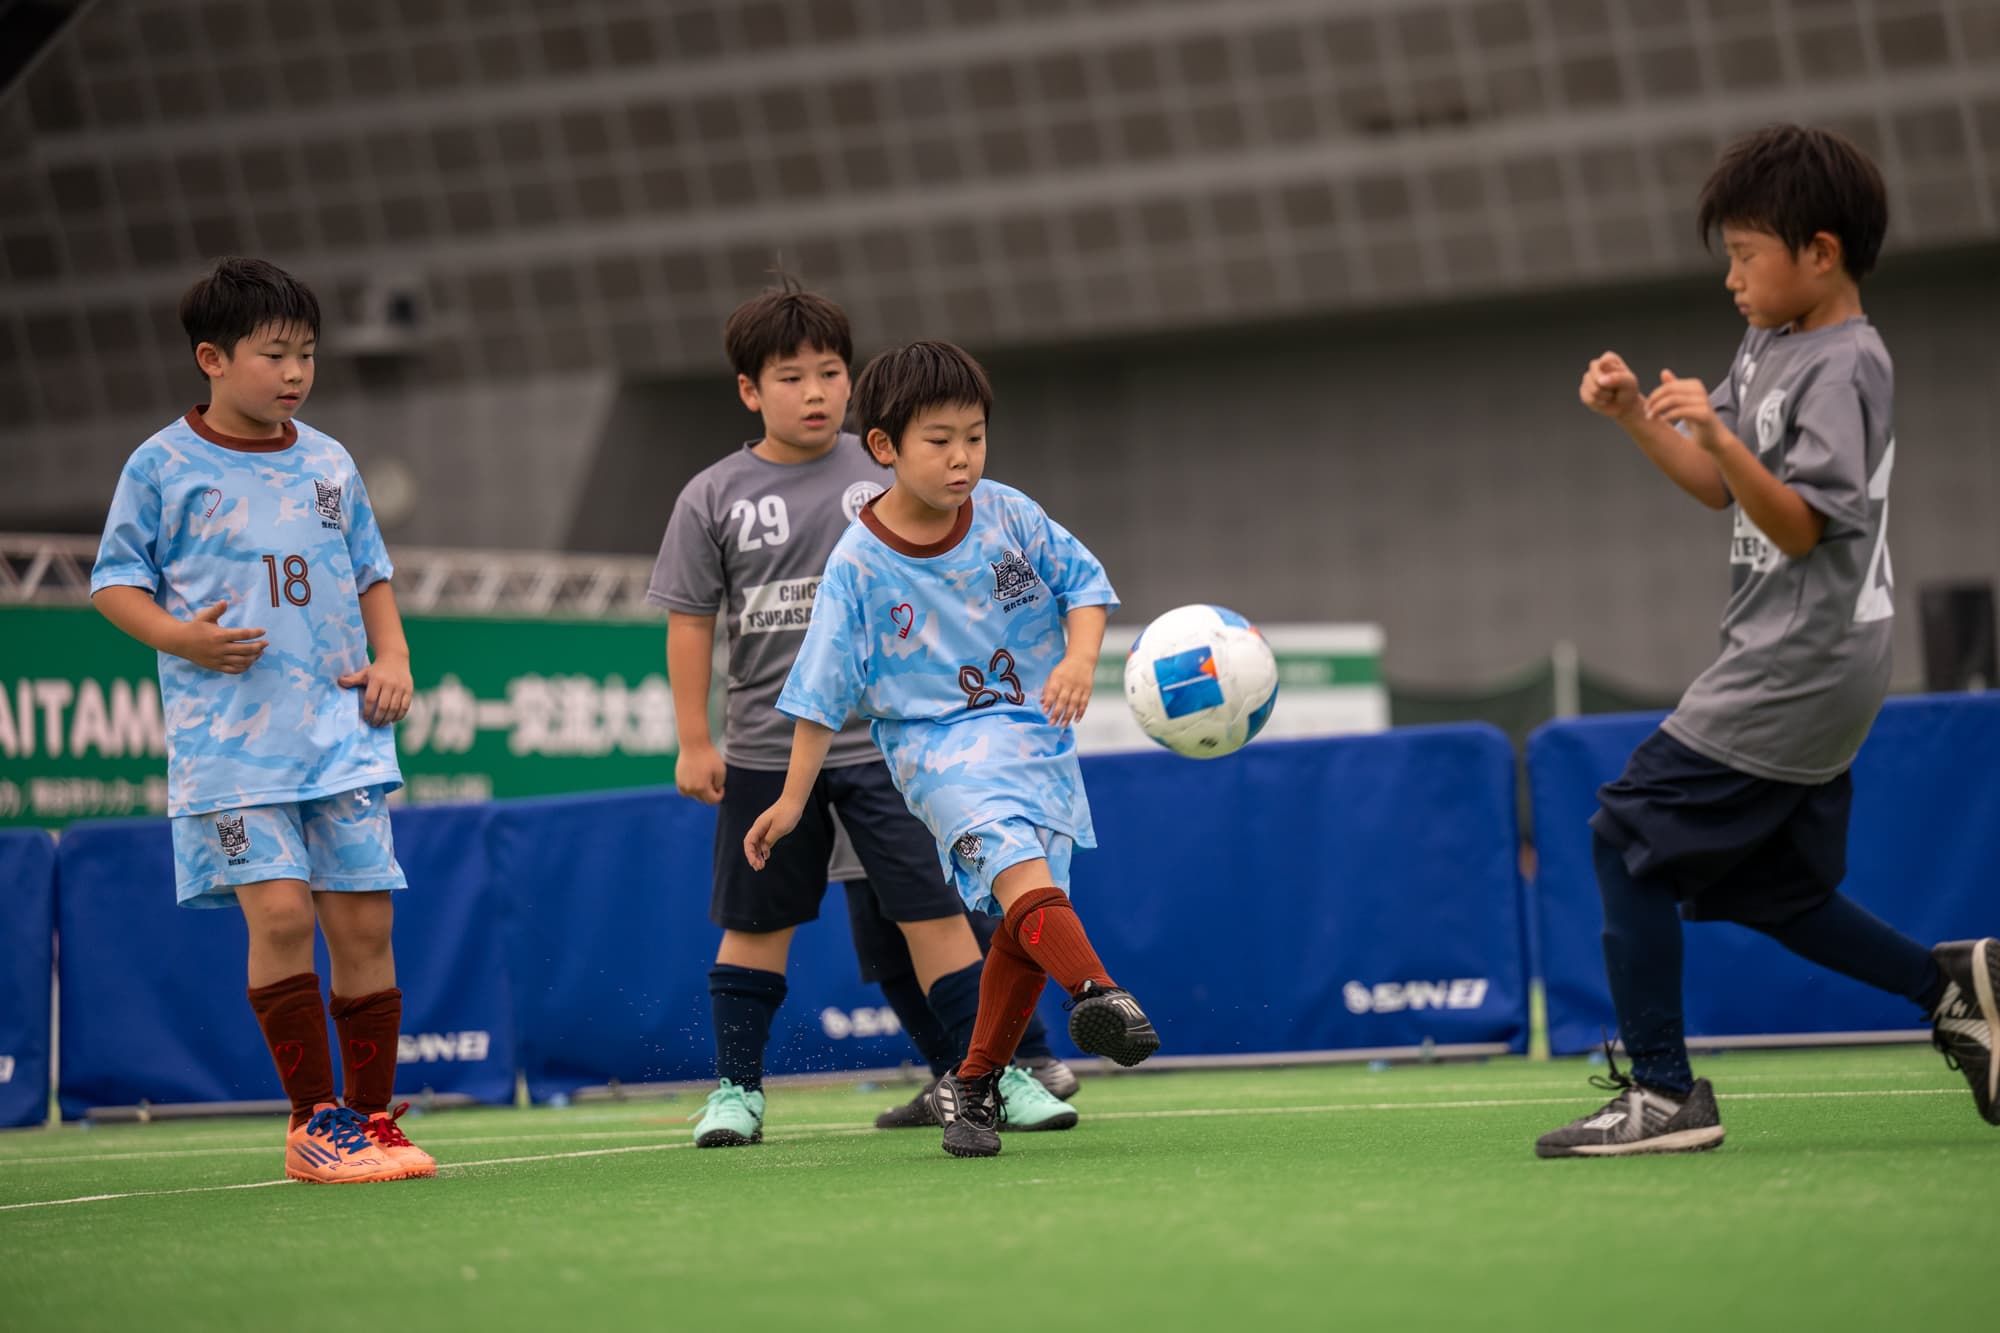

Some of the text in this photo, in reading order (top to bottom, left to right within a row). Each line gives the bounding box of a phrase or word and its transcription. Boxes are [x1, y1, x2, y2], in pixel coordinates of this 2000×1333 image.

[731, 495, 790, 552] 29
[262, 554, 311, 608] 18
[779, 582, 821, 602] CHIC
[959, 648, 1025, 709] 83
